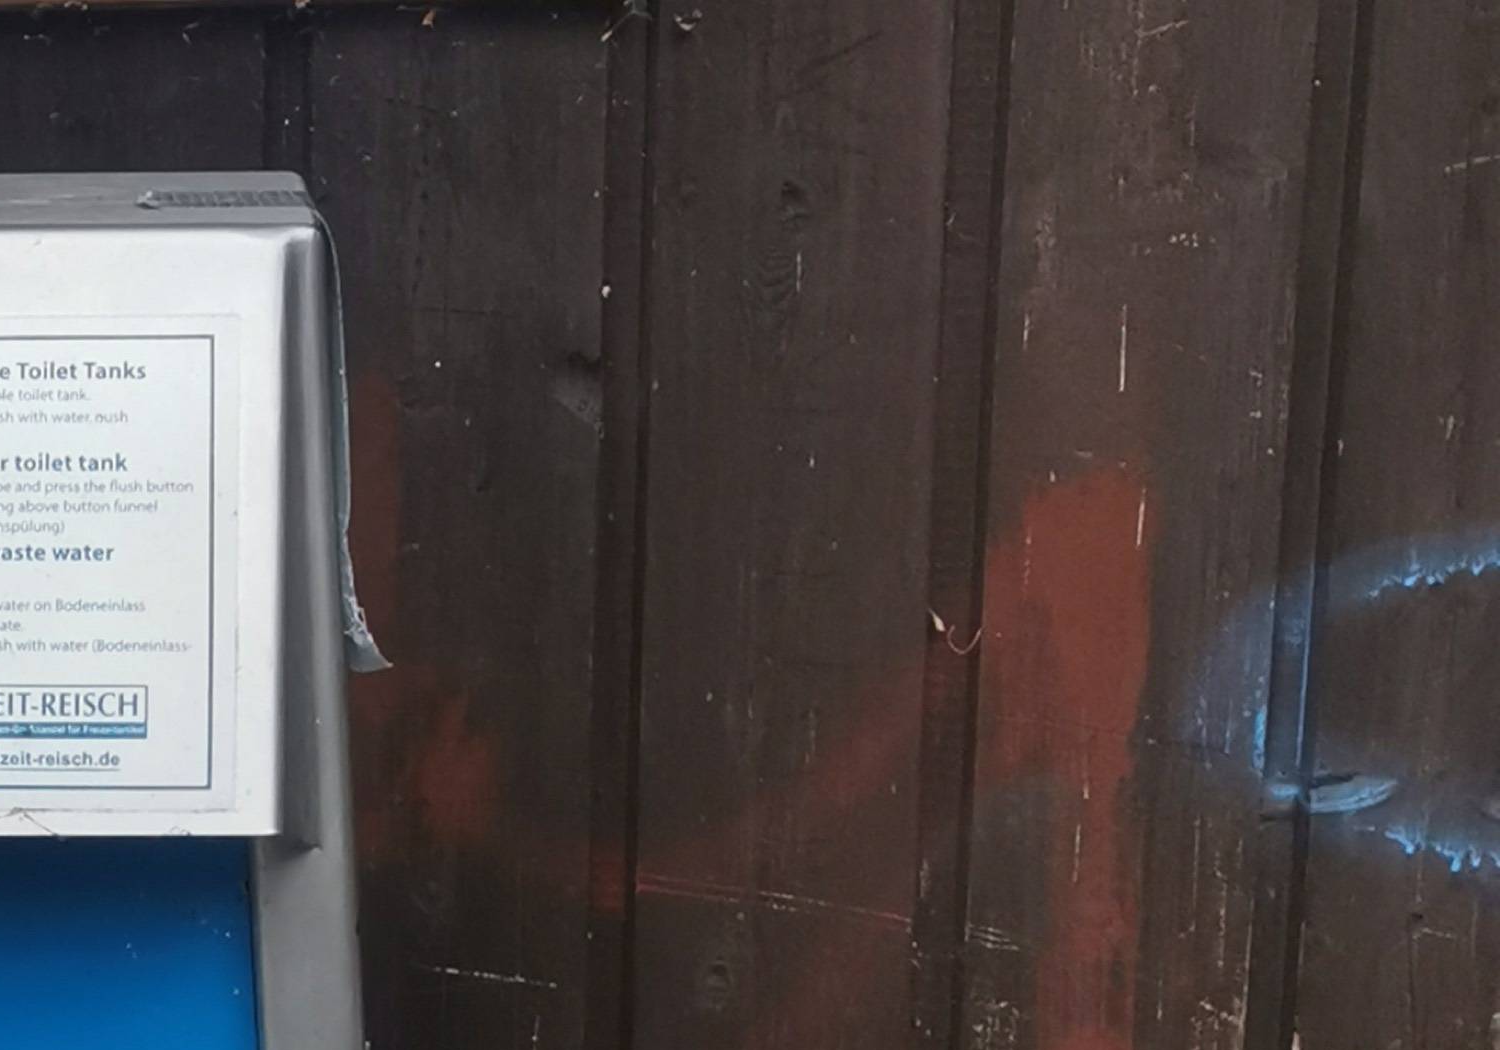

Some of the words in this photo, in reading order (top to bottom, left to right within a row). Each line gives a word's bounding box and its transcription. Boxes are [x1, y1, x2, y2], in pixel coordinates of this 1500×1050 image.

[17, 361, 77, 380] Toilet
[83, 361, 147, 380] Tanks
[18, 389, 54, 402] toilet
[18, 410, 48, 424] with
[15, 453, 72, 472] toilet
[78, 453, 127, 472] tank
[15, 480, 41, 493] and
[45, 482, 80, 496] press
[83, 480, 105, 493] the
[109, 480, 142, 493] flush
[146, 480, 194, 493] button
[18, 499, 59, 513] above
[63, 499, 109, 513] button
[113, 499, 158, 513] funnel
[52, 545, 114, 561] water
[34, 600, 52, 611] on
[16, 637, 46, 651] with
[50, 638, 88, 651] water
